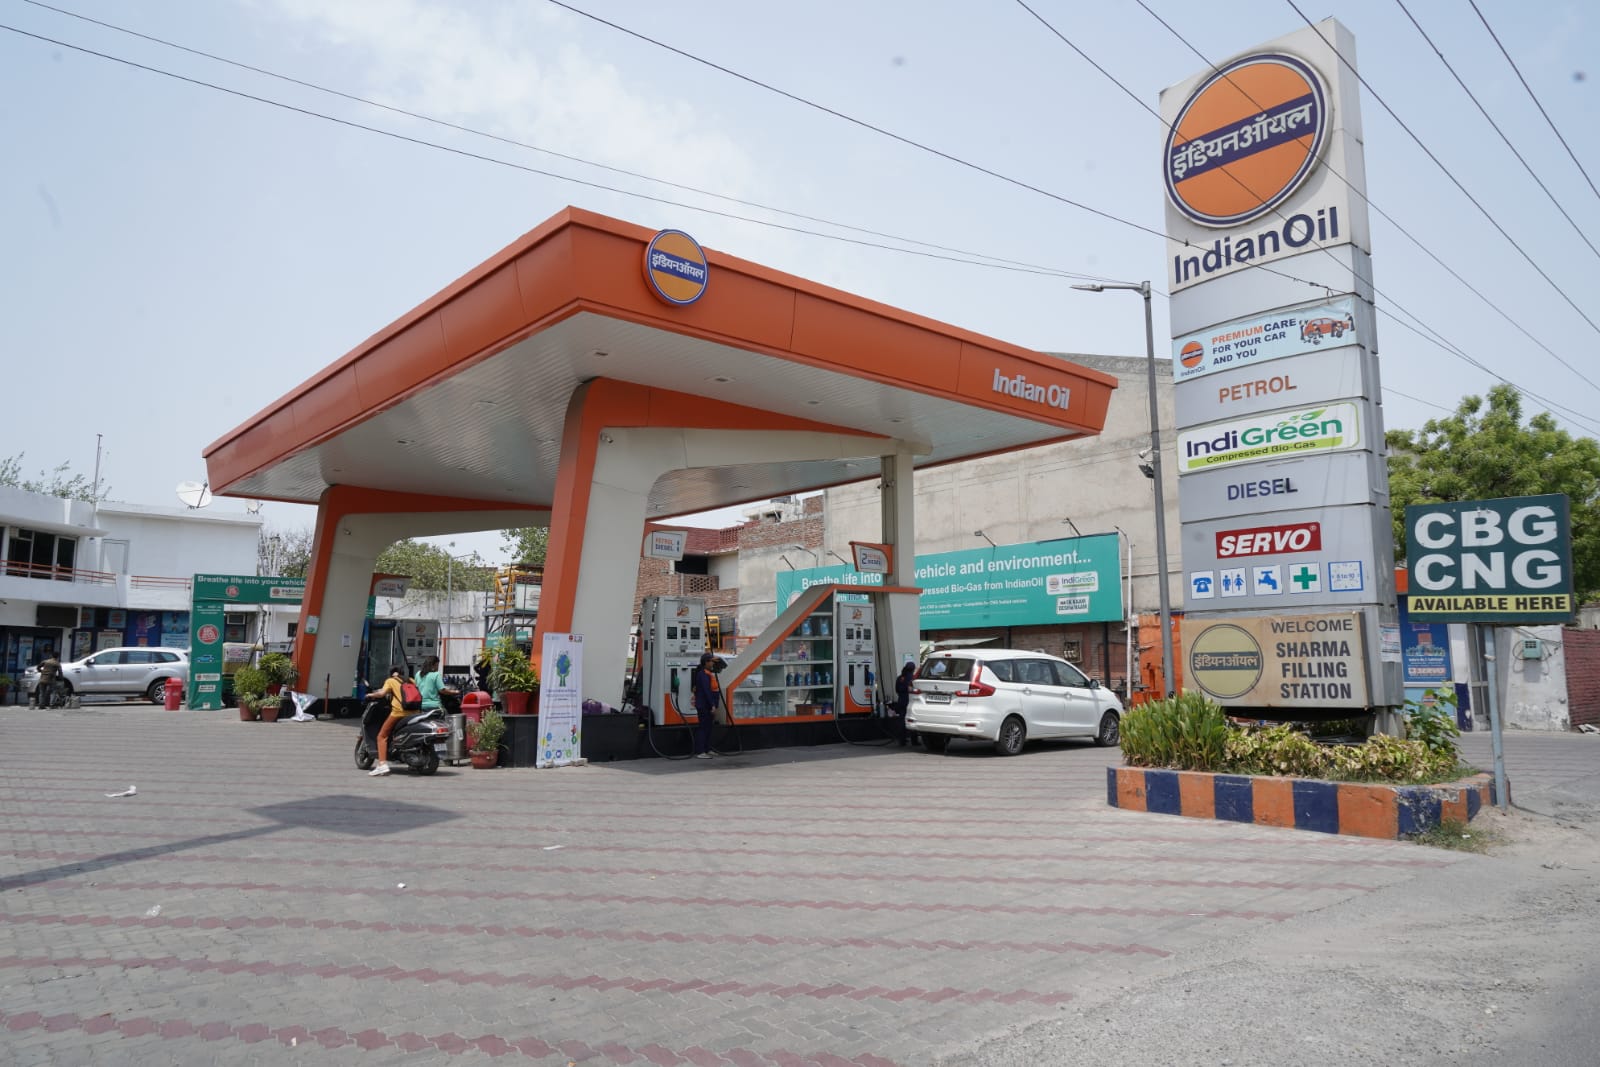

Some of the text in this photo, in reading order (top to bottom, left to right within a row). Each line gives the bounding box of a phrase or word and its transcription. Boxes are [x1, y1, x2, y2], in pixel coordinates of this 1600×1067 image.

[1173, 102, 1312, 178] इंडियनऑयल
[1175, 206, 1339, 284] IndianOil
[1212, 331, 1286, 354] FOR YOUR CAR
[1213, 354, 1233, 365] AND
[1236, 349, 1258, 360] YOU
[1219, 375, 1297, 403] PETROL
[1187, 419, 1342, 457] IndiGreen
[1206, 441, 1316, 464] Compressed Bio-Gas
[1227, 478, 1298, 500] DIESEL
[1414, 505, 1558, 549] CBG
[860, 571, 882, 585] into
[914, 563, 957, 580] vehicle
[960, 558, 984, 574] and
[1414, 549, 1562, 591] CNG
[951, 579, 982, 593] Bio-Gas
[984, 579, 1003, 591] from
[1005, 577, 1044, 590] IndianOil
[1413, 596, 1566, 611] AVAILABLE HERE
[1271, 619, 1353, 633] WELCOME
[1276, 641, 1350, 658] SHARMA
[1194, 653, 1258, 669] इंडियनऑयल
[1281, 661, 1348, 678] FILLING
[1280, 682, 1352, 699] STATION
